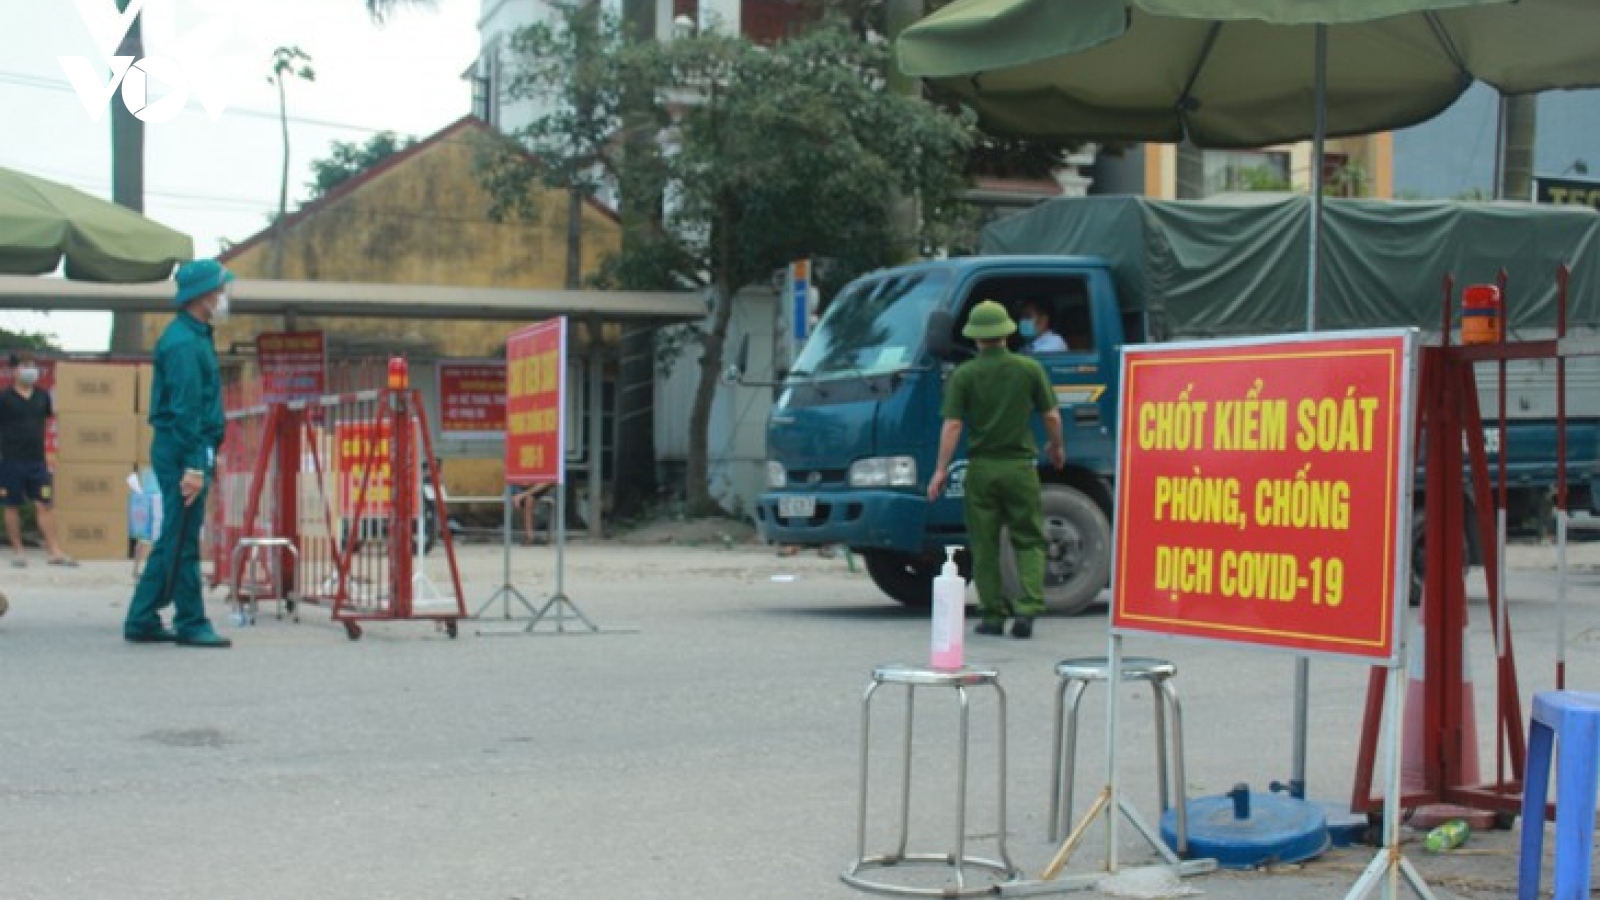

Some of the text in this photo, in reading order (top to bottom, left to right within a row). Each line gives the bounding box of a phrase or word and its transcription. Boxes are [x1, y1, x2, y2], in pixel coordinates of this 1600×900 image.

[1139, 378, 1379, 452] CHỐT KIỂM SOÁT
[1155, 463, 1350, 529] PHÒNG, CHỐNG
[1155, 546, 1344, 606] DỊCH COVID-19
